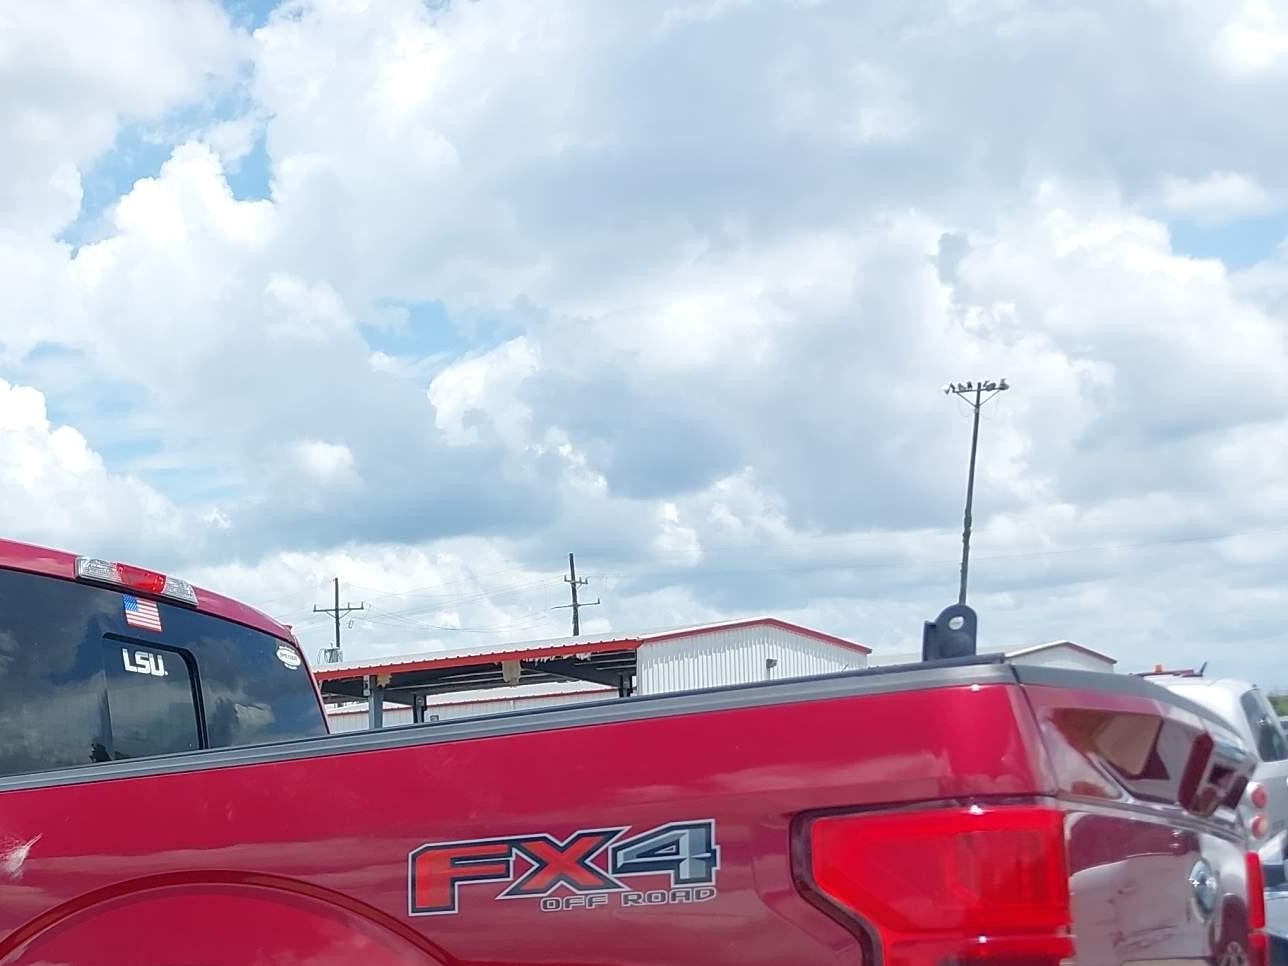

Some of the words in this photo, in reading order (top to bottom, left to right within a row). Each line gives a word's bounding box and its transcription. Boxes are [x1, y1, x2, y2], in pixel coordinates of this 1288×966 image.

[409, 819, 720, 917] FX4
[540, 893, 609, 912] OFF
[621, 886, 717, 908] ROAD
